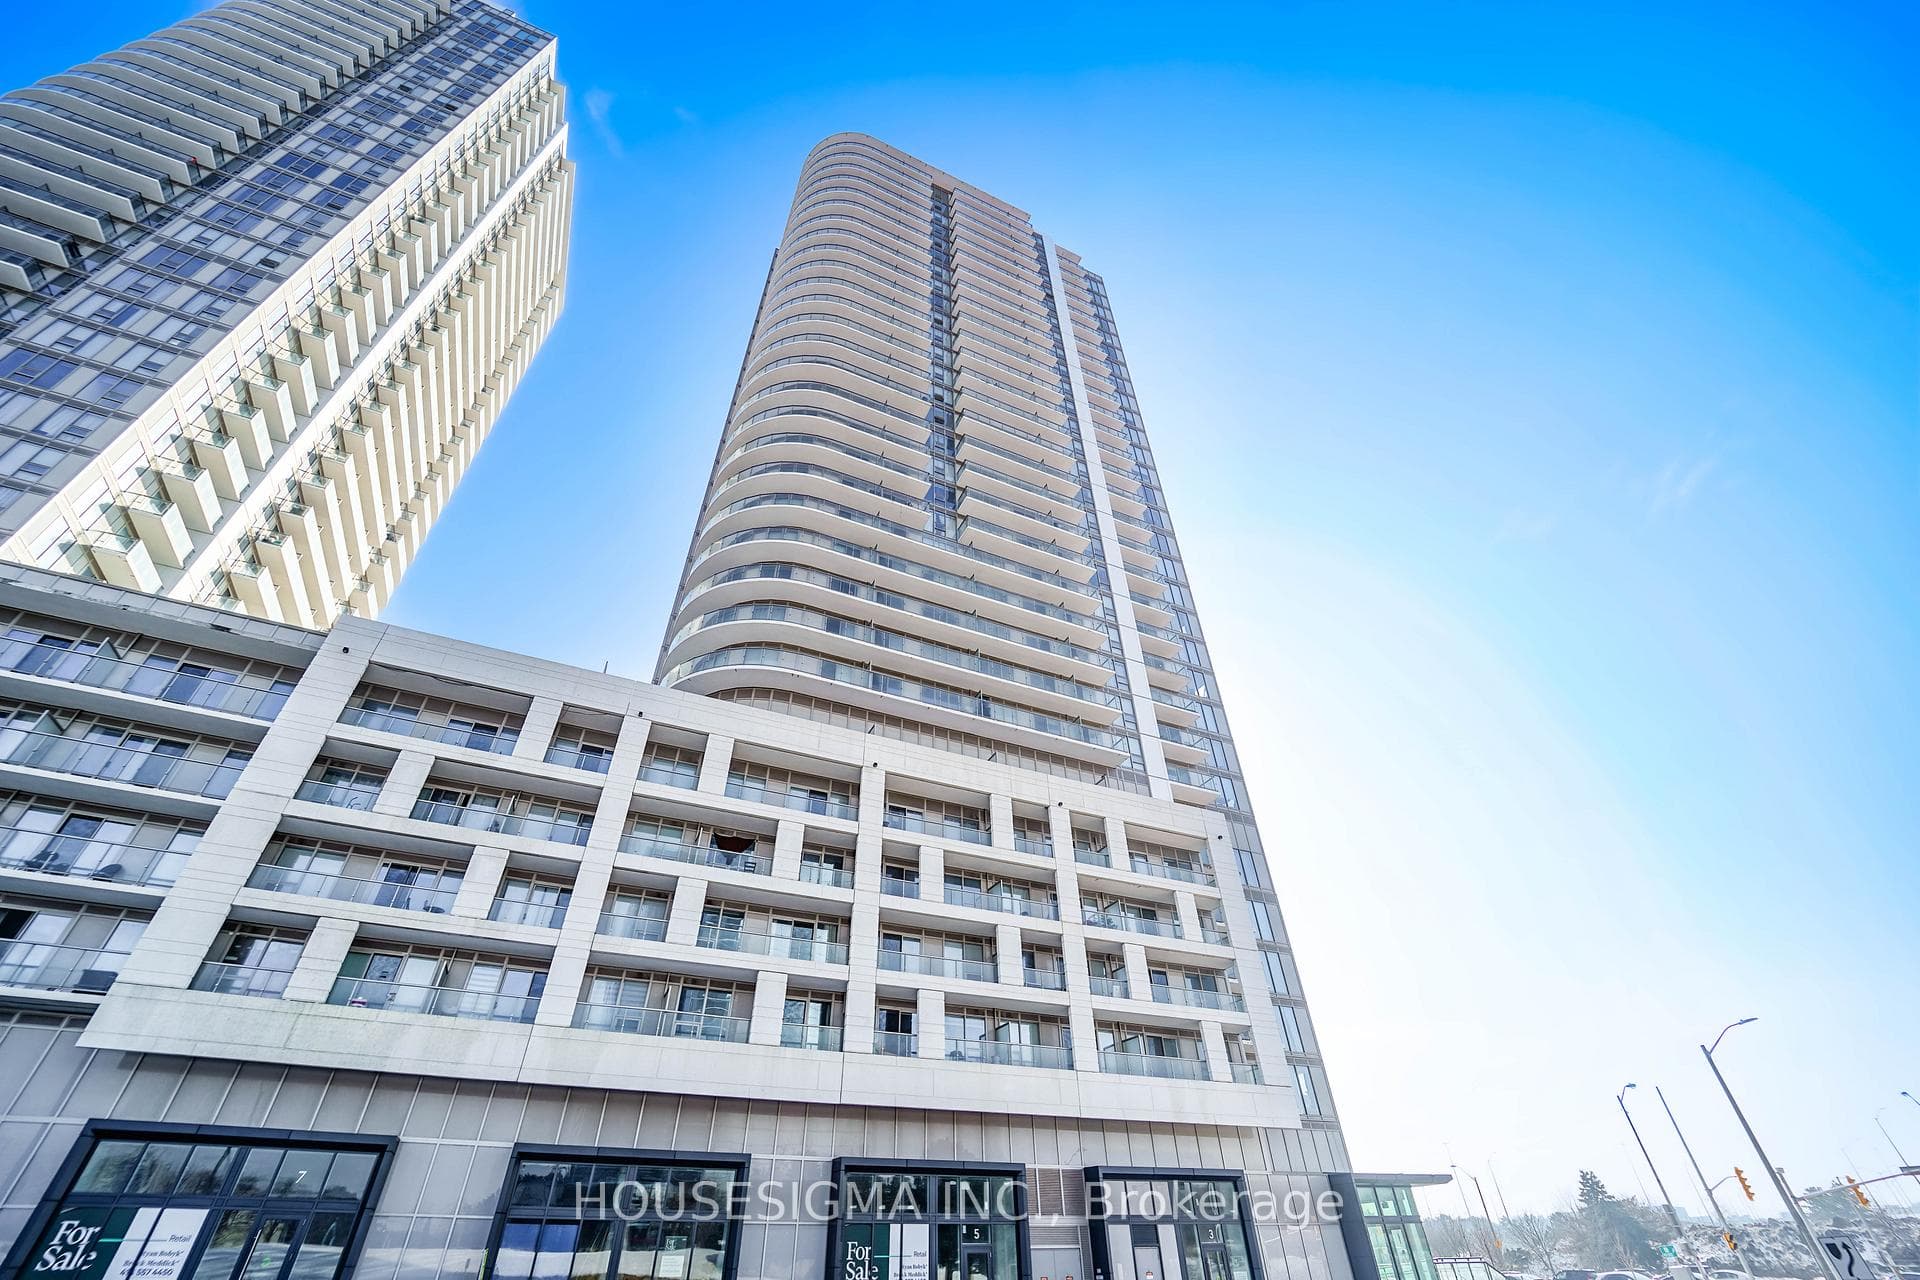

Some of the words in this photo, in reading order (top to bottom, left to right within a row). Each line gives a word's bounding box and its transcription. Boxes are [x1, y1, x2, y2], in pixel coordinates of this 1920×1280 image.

[295, 1170, 308, 1184] 7
[48, 1219, 103, 1246] For
[973, 1228, 981, 1240] 5
[1208, 1229, 1215, 1240] 3
[33, 1243, 98, 1272] Sale
[846, 1241, 872, 1261] For
[845, 1260, 879, 1280] Sale
